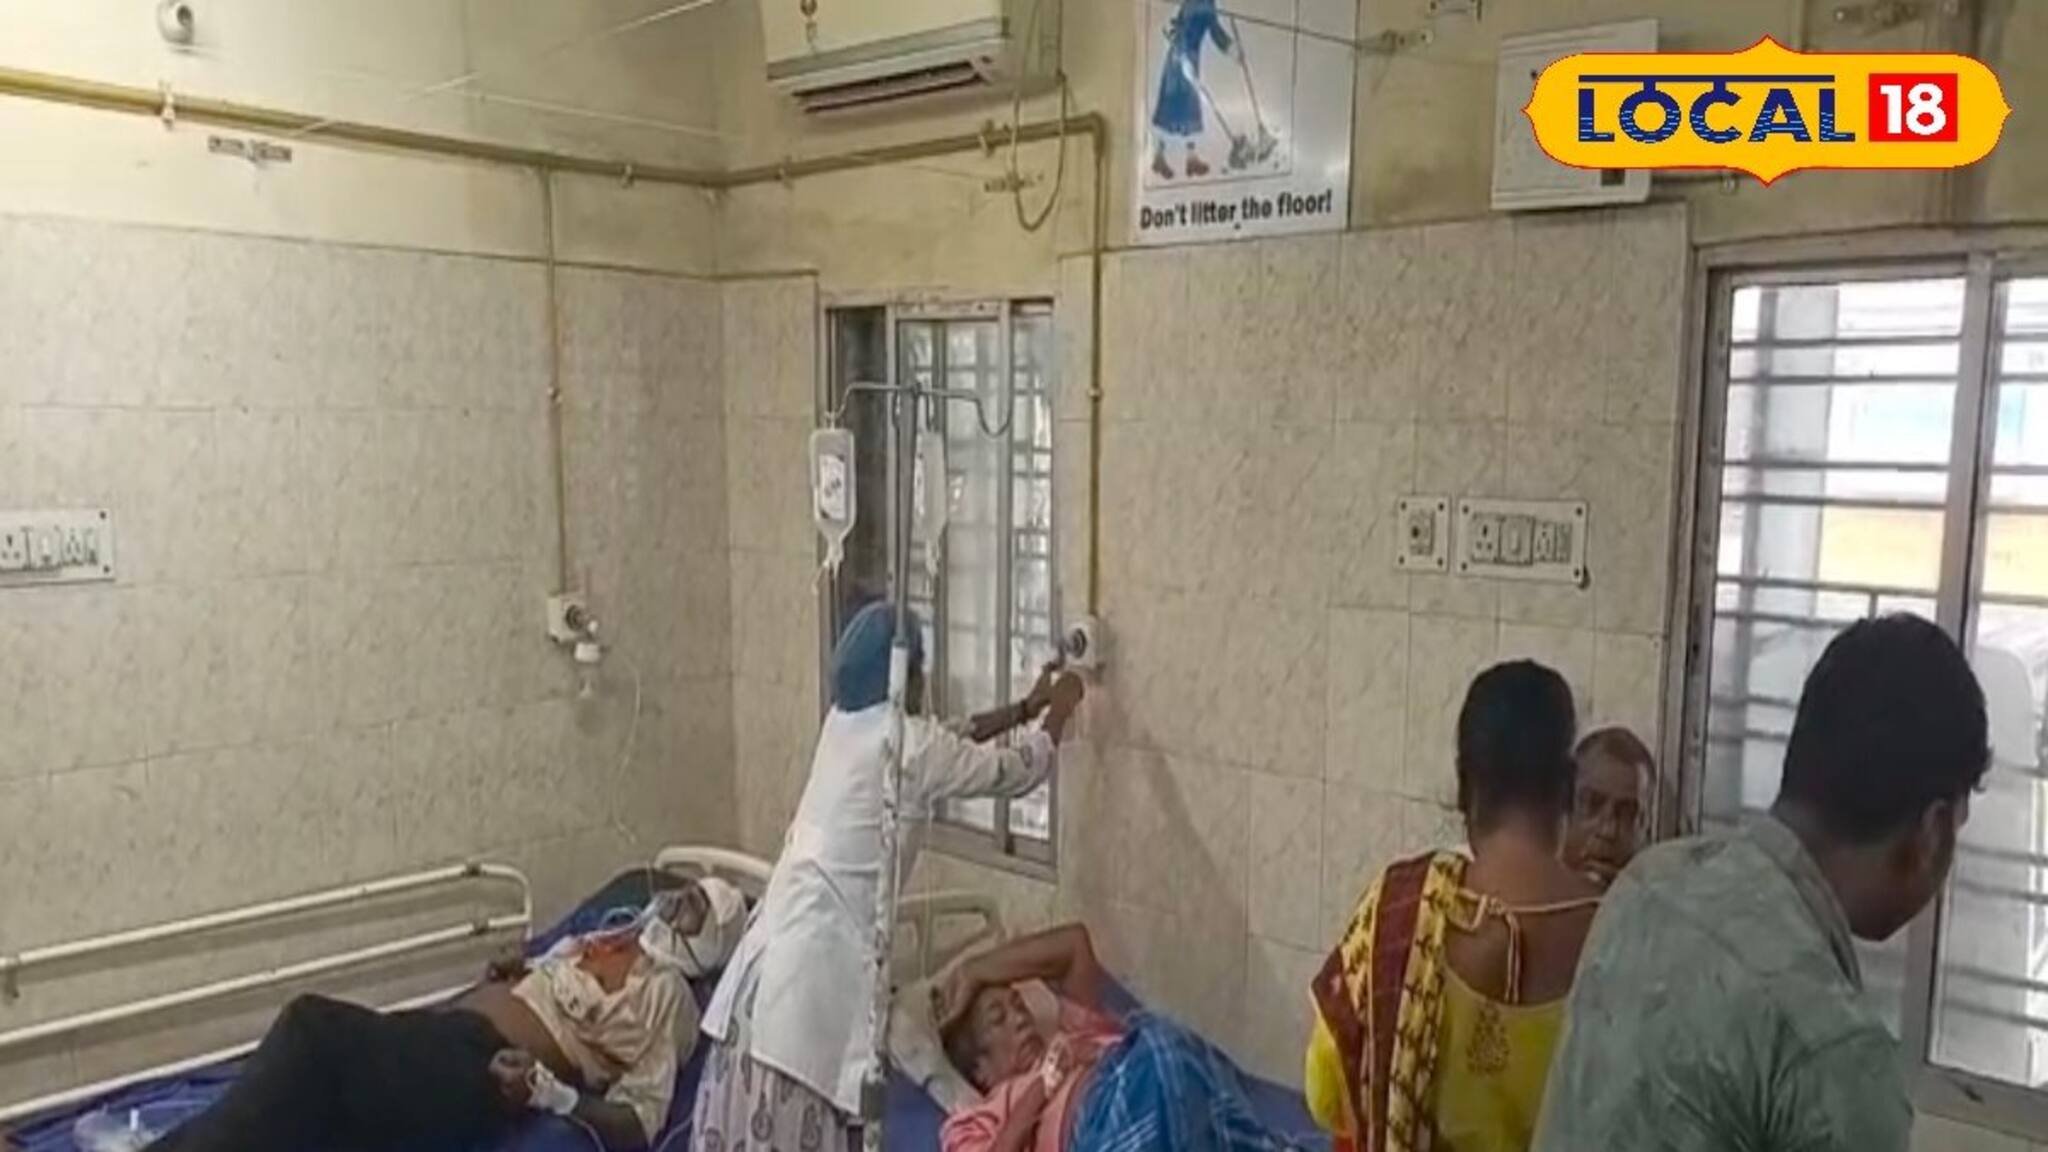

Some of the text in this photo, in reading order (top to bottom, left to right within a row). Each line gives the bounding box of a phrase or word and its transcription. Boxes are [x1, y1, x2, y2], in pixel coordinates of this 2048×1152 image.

[1140, 188, 1333, 229] Don't litter the floor!
